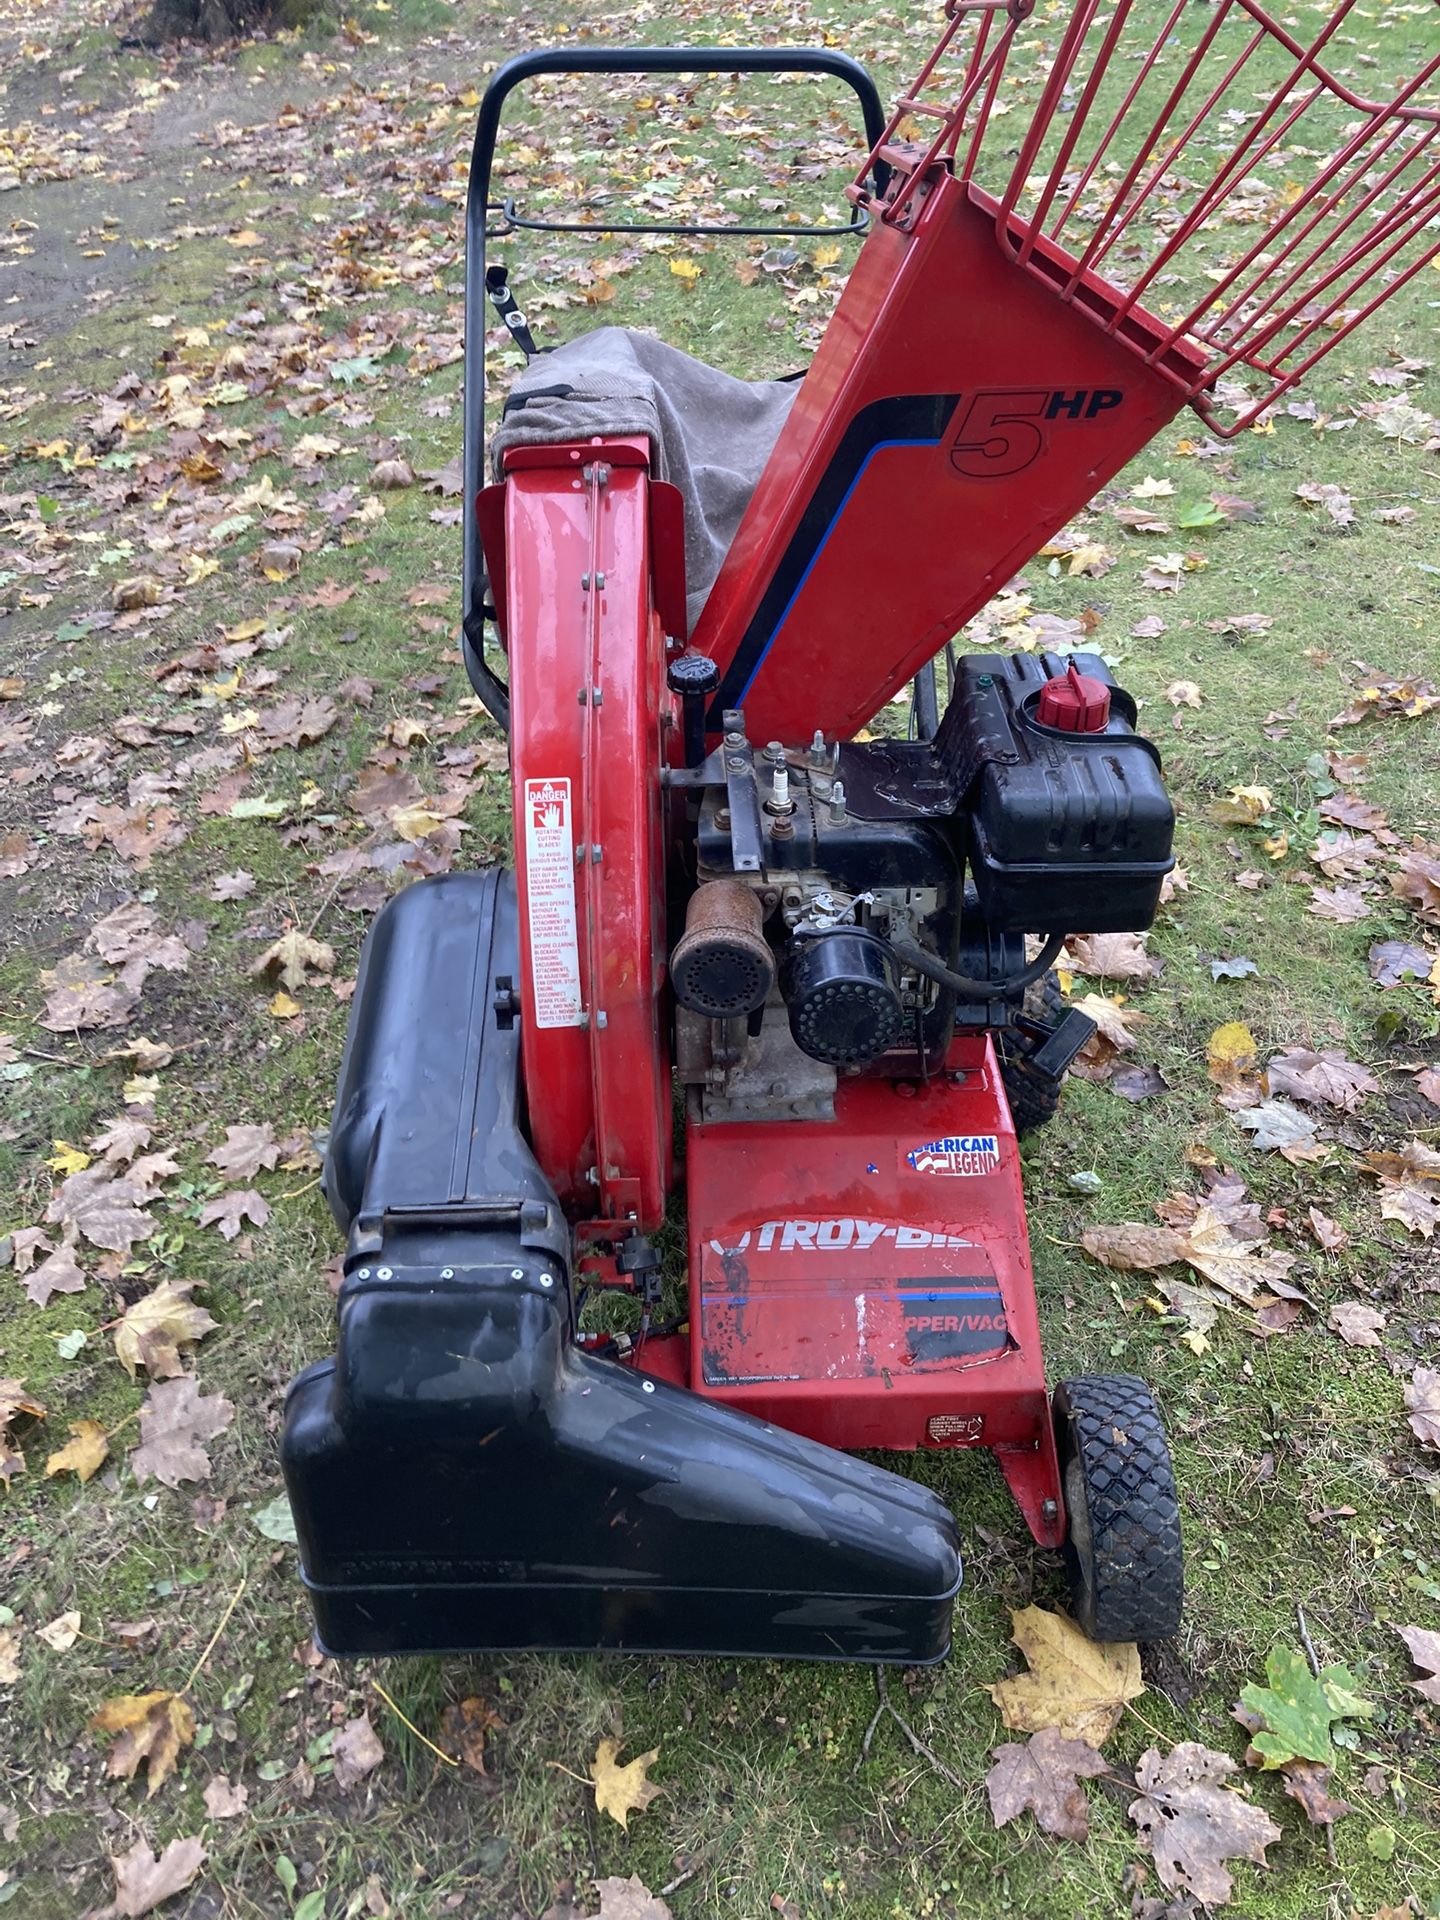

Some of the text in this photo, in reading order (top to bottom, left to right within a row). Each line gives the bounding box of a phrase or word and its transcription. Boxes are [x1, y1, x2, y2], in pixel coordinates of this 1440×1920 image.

[950, 390, 1123, 478] 5 HP
[529, 790, 567, 800] DANGER
[947, 1152, 997, 1174] LEGEND
